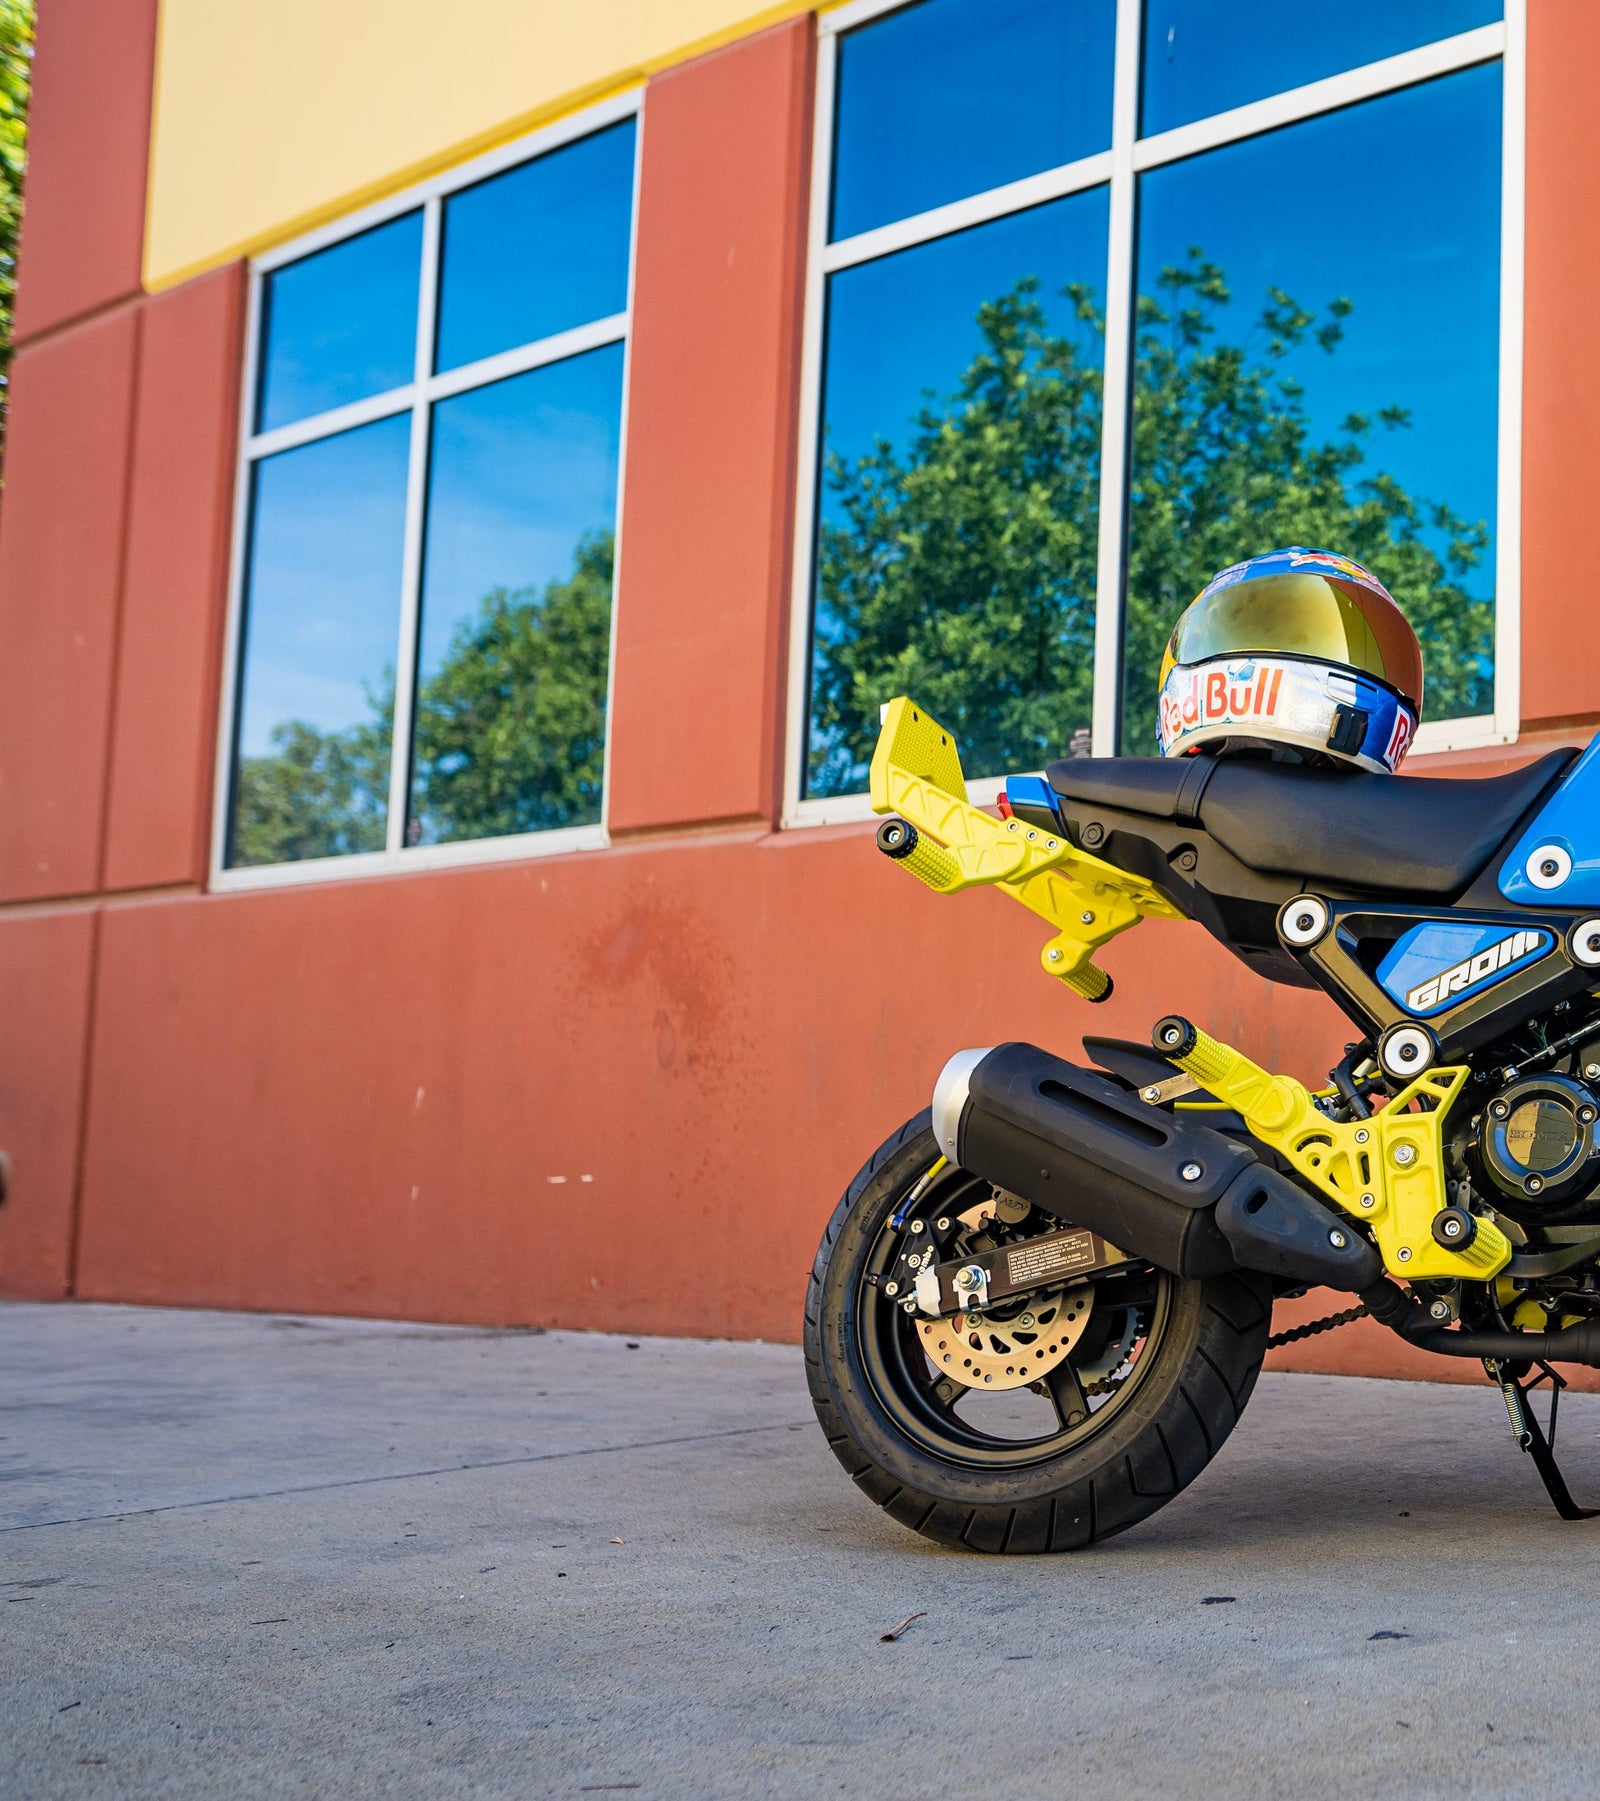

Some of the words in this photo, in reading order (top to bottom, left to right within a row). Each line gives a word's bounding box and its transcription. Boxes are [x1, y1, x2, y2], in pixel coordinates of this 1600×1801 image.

[1161, 674, 1200, 743] Red
[1206, 667, 1284, 719] Bull
[1407, 931, 1540, 1012] GROM
